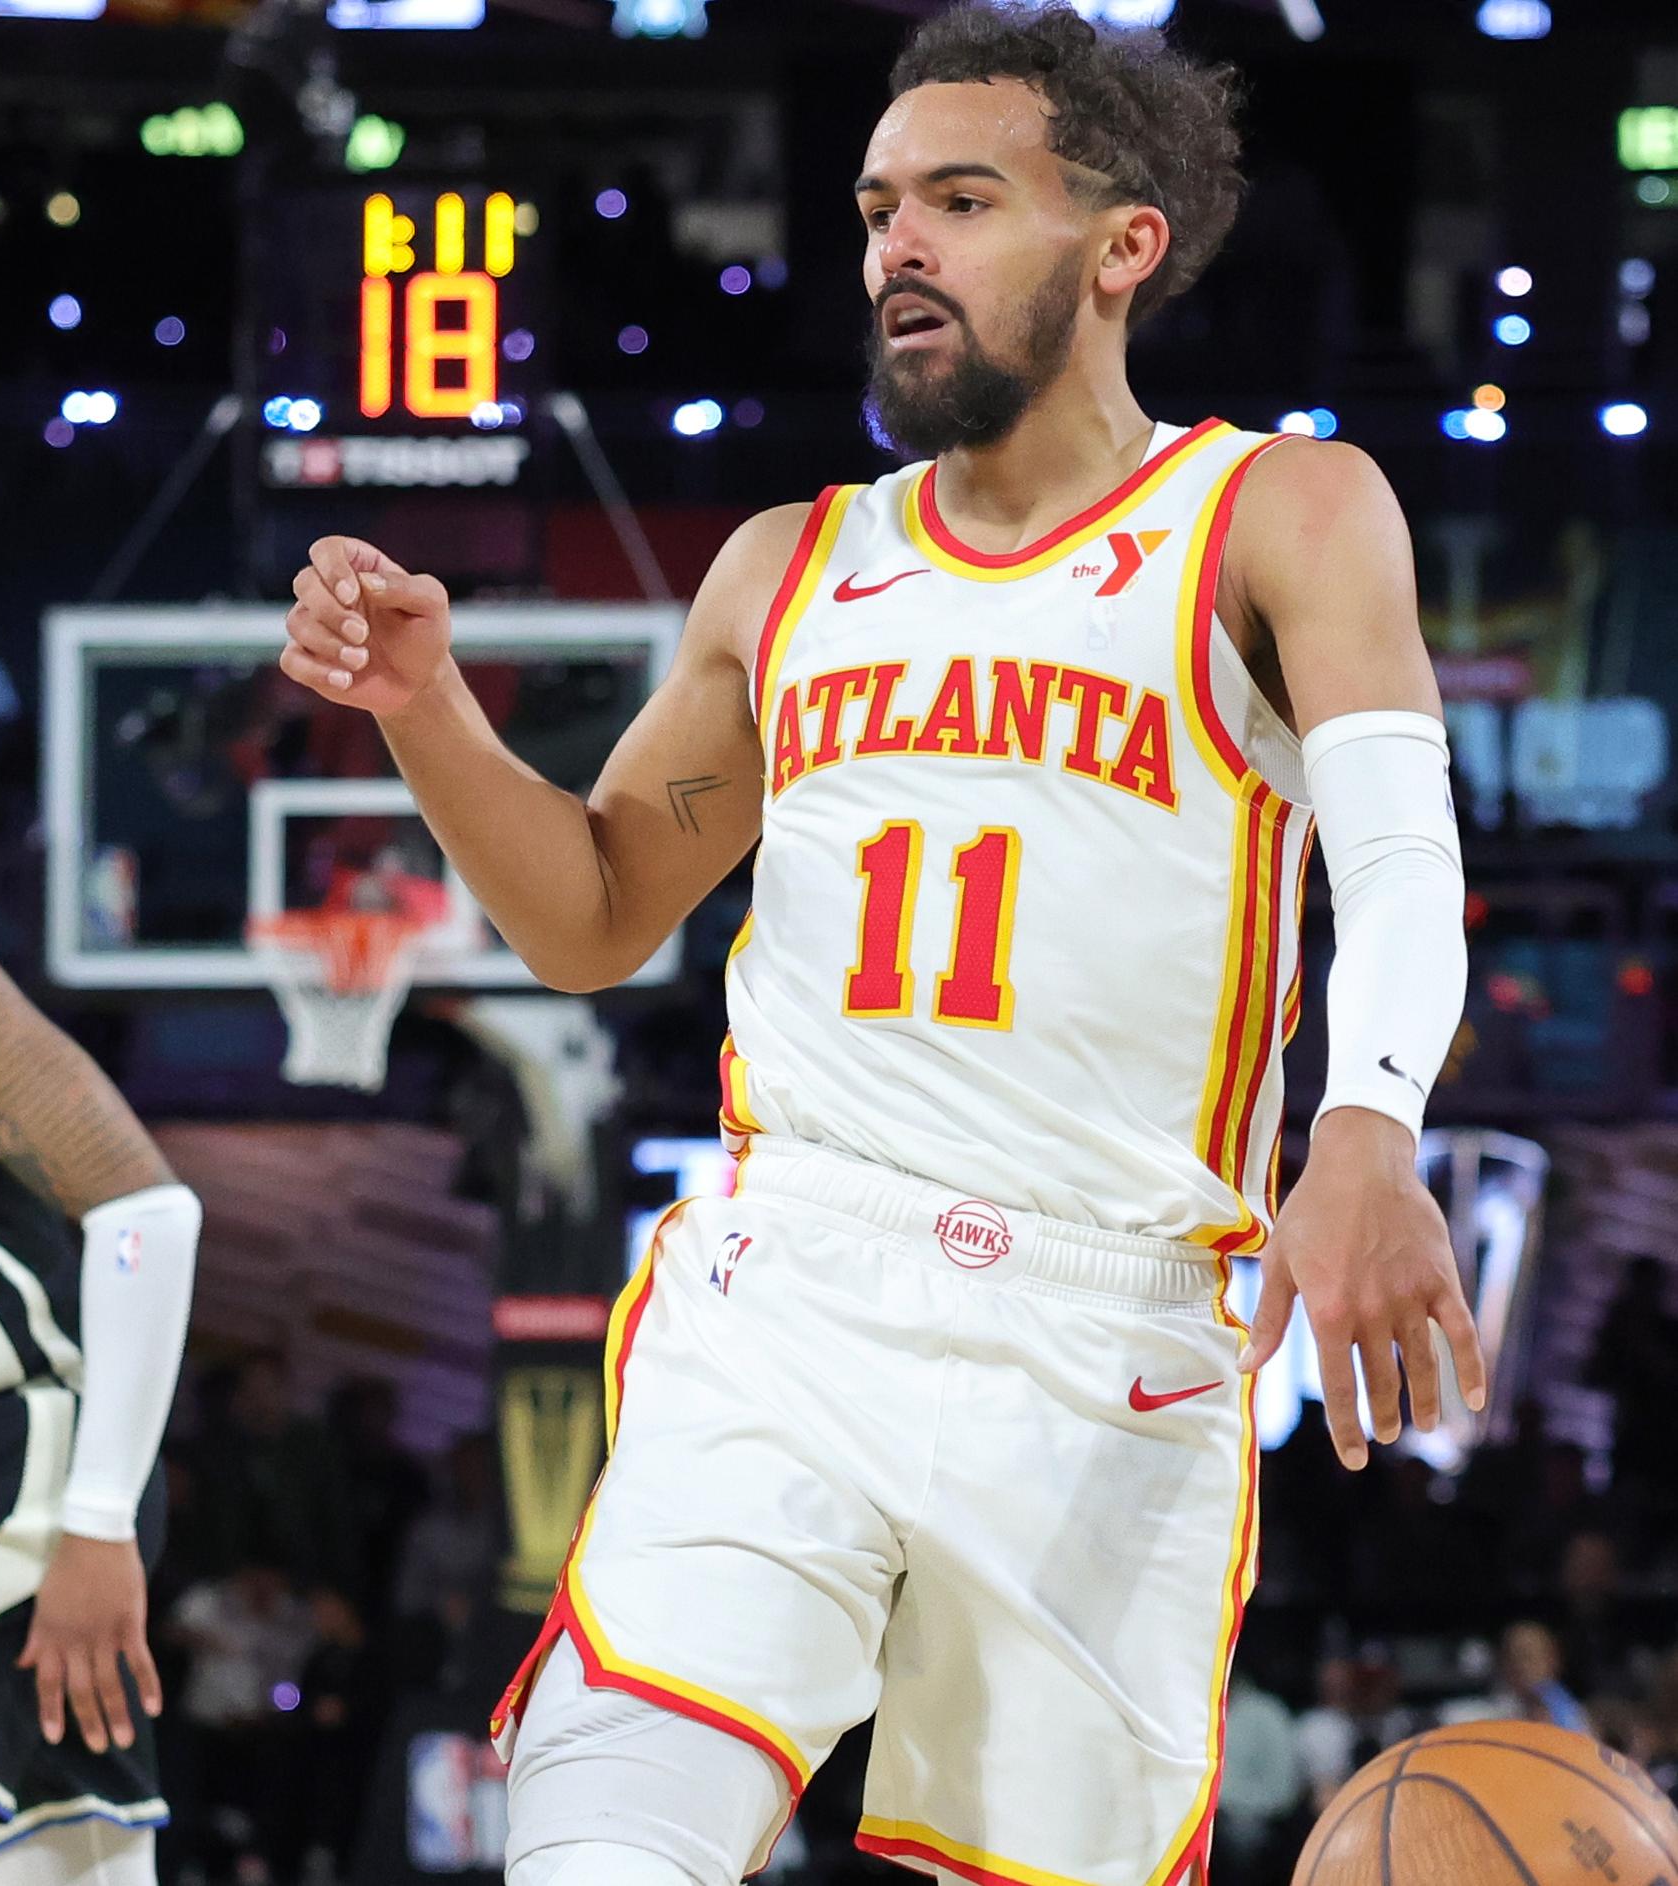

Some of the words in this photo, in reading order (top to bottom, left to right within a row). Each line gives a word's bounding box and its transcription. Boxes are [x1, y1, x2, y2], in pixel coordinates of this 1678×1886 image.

[359, 271, 498, 420] 18
[1071, 563, 1102, 579] the
[771, 655, 1179, 816] ATLANTA
[841, 818, 1021, 1032] 11
[932, 1213, 1014, 1256] HAWKS
